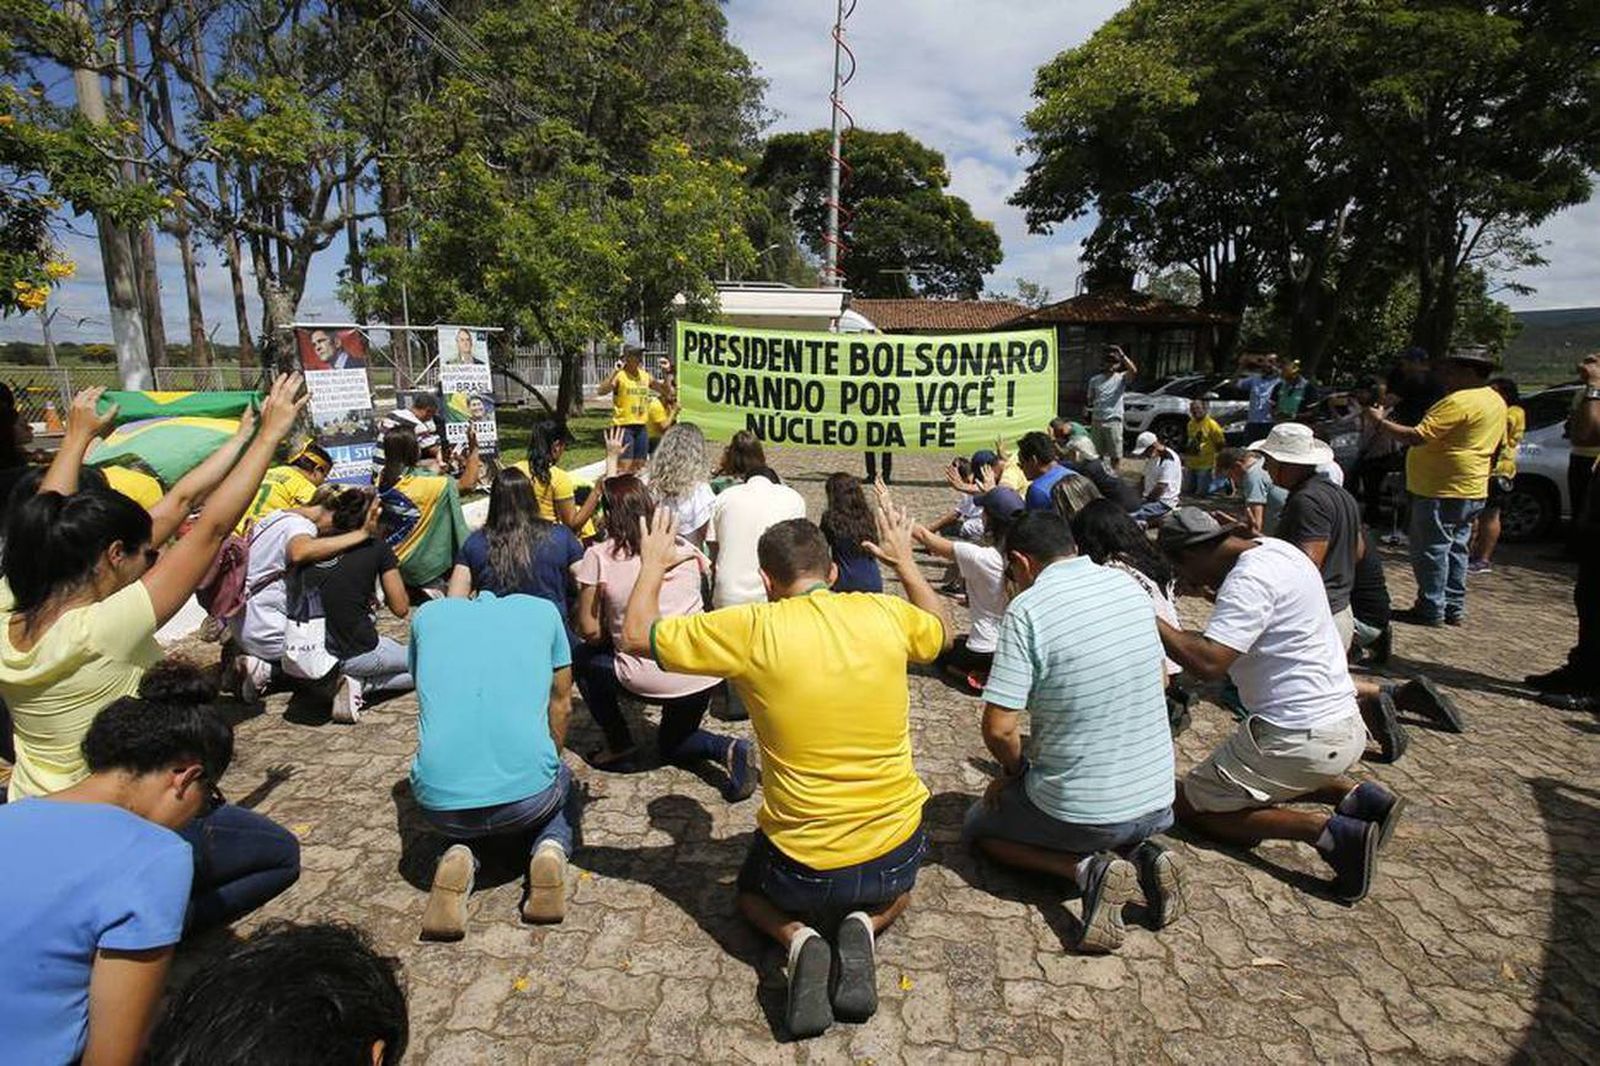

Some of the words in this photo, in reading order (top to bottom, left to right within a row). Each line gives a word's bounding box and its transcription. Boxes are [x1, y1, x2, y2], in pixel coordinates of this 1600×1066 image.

[684, 330, 839, 375] PRESIDENTE
[850, 339, 1049, 377] BOLSONARO
[707, 371, 825, 414] ORANDO
[840, 380, 900, 417] POR
[916, 376, 995, 417] VOCÊ
[746, 412, 858, 447] NÚCLEO
[866, 422, 906, 447] DA
[920, 417, 956, 447] FÉ
